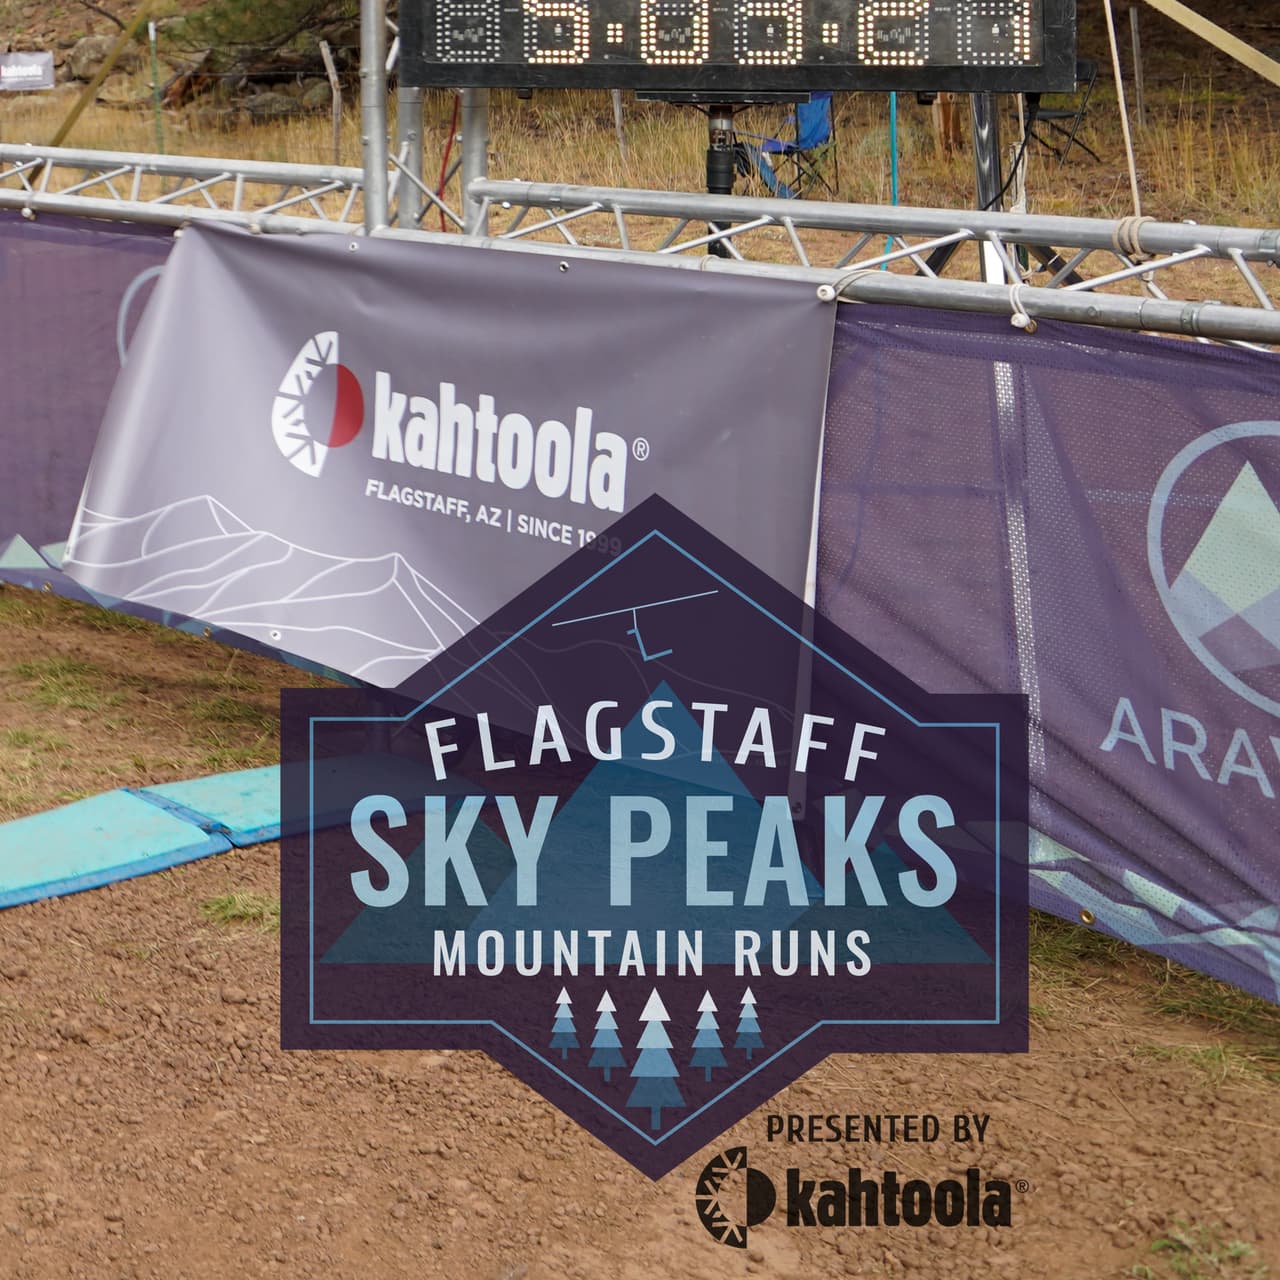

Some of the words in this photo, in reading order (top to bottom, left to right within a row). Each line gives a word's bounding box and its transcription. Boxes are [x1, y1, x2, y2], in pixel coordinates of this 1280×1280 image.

[364, 478, 471, 523] FLAGSTAFF,
[476, 504, 503, 528] AZ
[517, 514, 573, 545] SINCE
[1100, 696, 1280, 799] ARA
